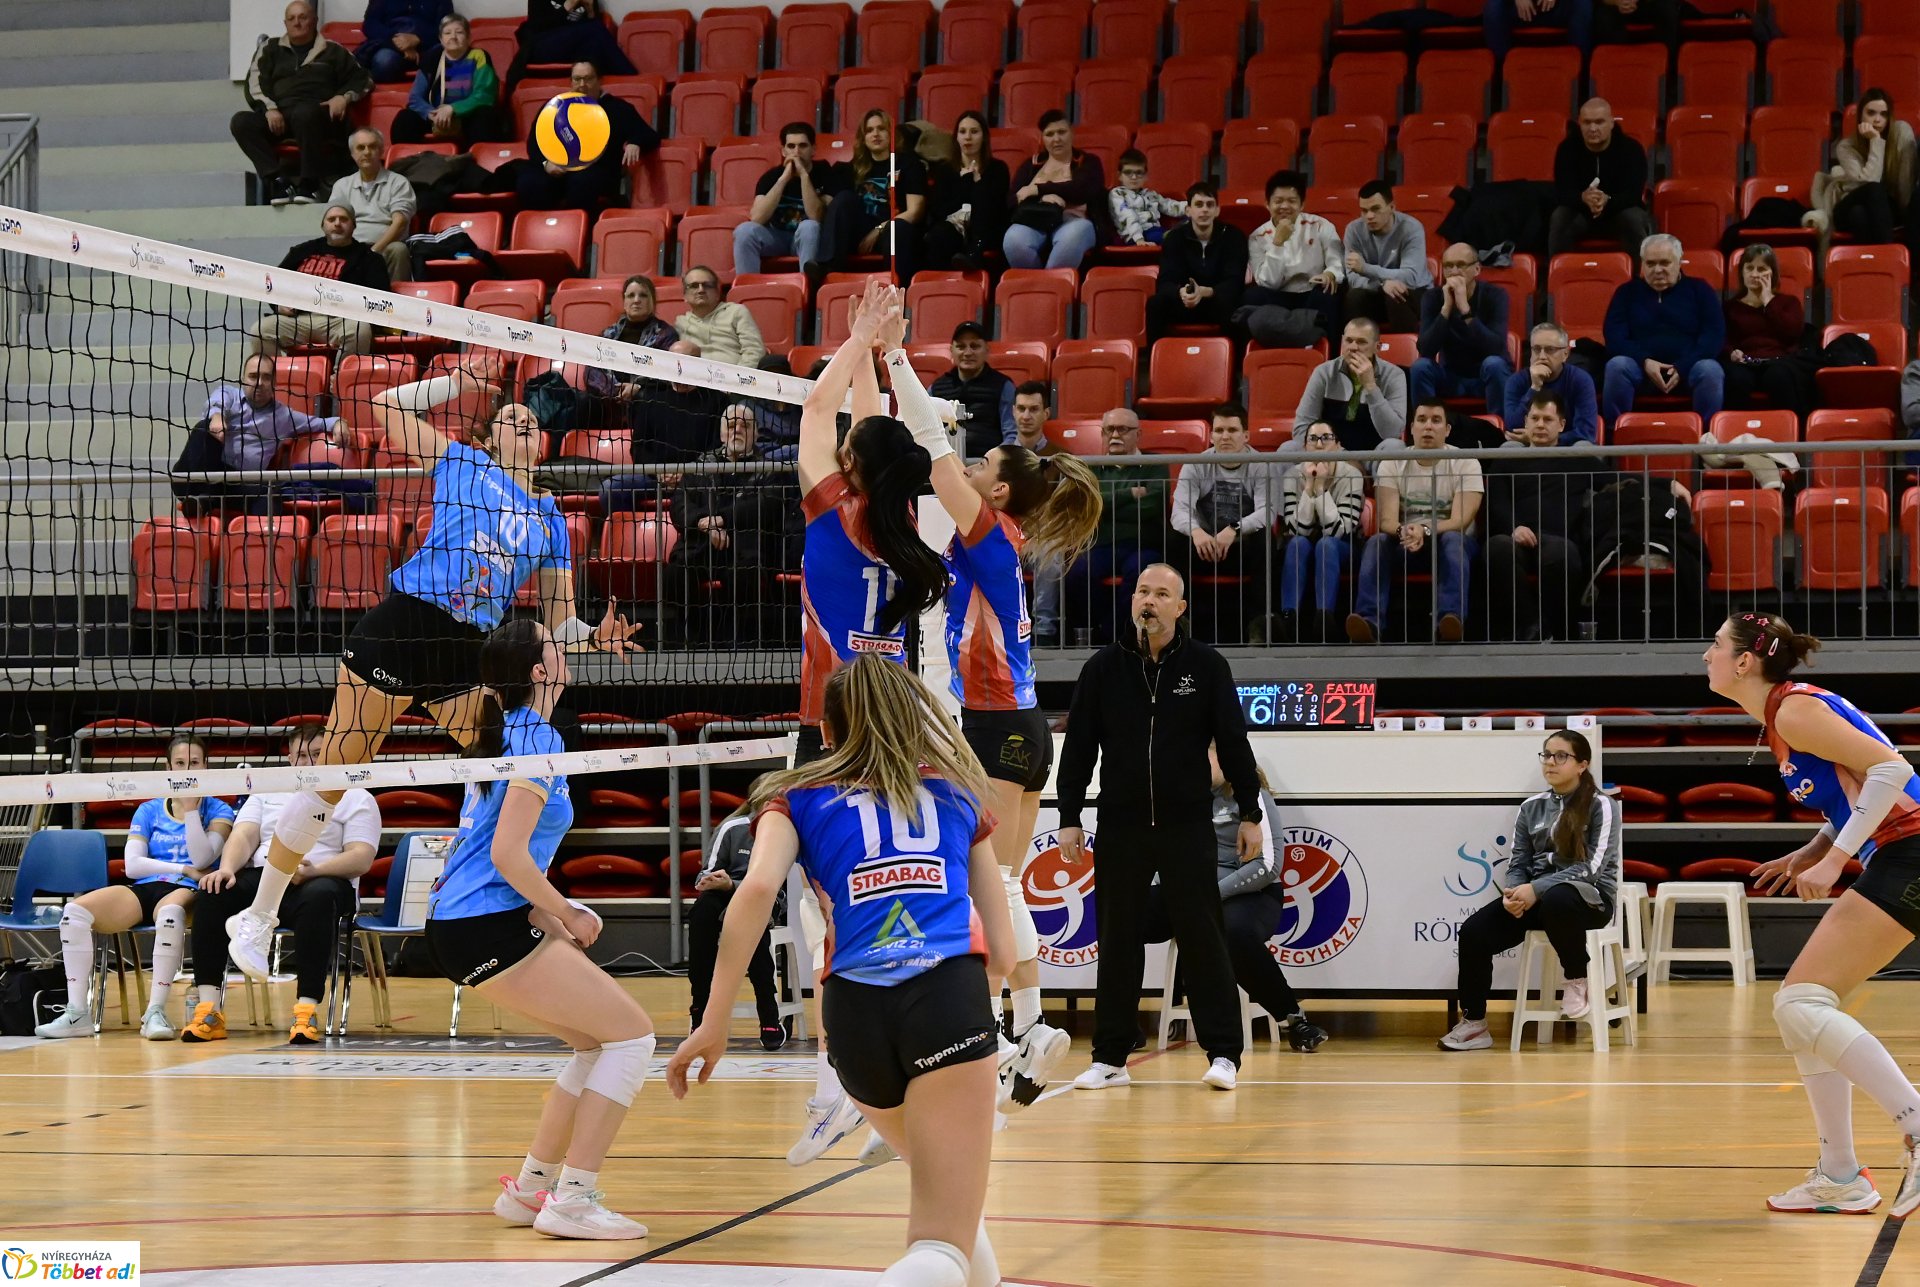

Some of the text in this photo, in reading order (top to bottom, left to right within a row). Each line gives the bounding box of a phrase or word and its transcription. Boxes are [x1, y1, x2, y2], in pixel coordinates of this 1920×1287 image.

[189, 258, 225, 278] TippmixPRO
[363, 295, 393, 315] TippmixPRO
[1235, 683, 1281, 695] enedek
[1326, 683, 1375, 694] FATUM
[1324, 695, 1366, 724] 21
[846, 786, 941, 859] 10
[852, 866, 942, 892] STRABAG
[909, 940, 925, 949] 21
